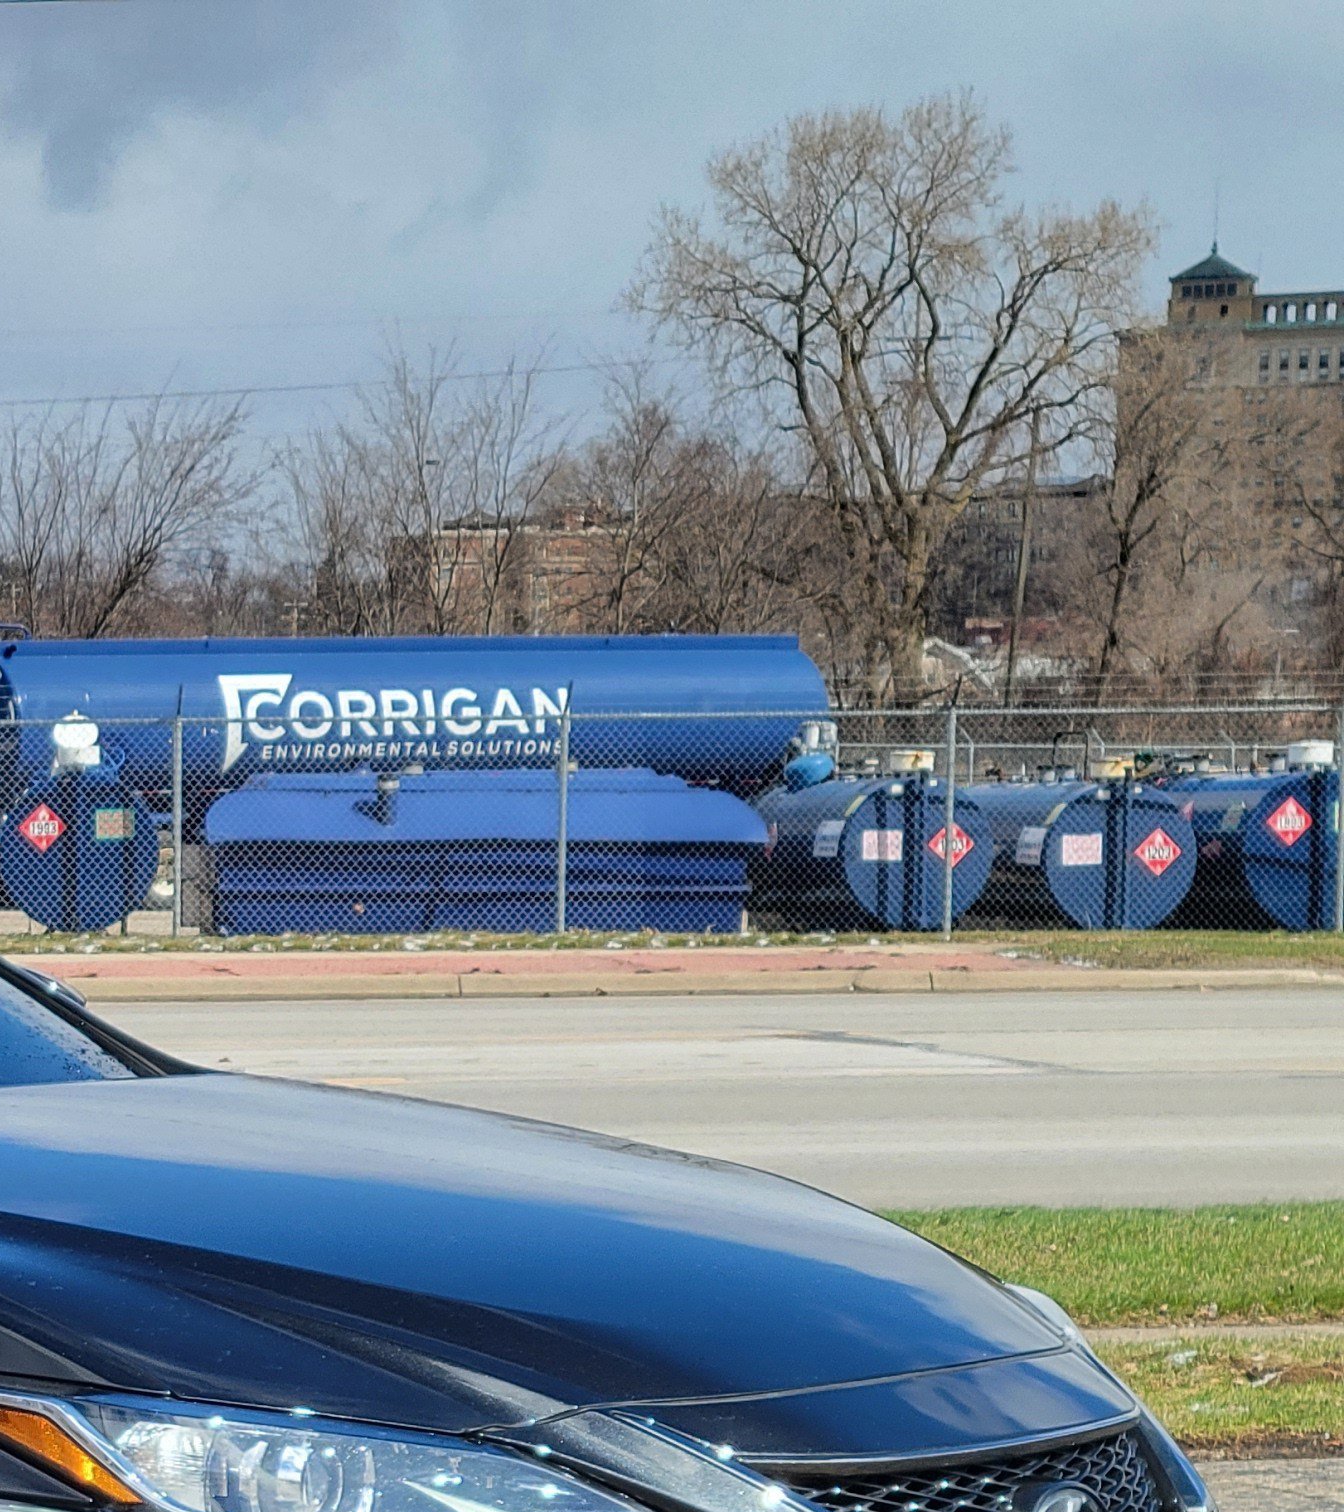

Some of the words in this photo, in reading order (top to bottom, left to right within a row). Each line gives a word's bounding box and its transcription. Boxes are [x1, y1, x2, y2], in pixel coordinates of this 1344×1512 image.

[244, 687, 571, 740] CORRIGAN
[261, 740, 442, 760] ENVIRONMENTAL
[447, 738, 562, 757] SOLUTIONS
[31, 822, 57, 835] 1993
